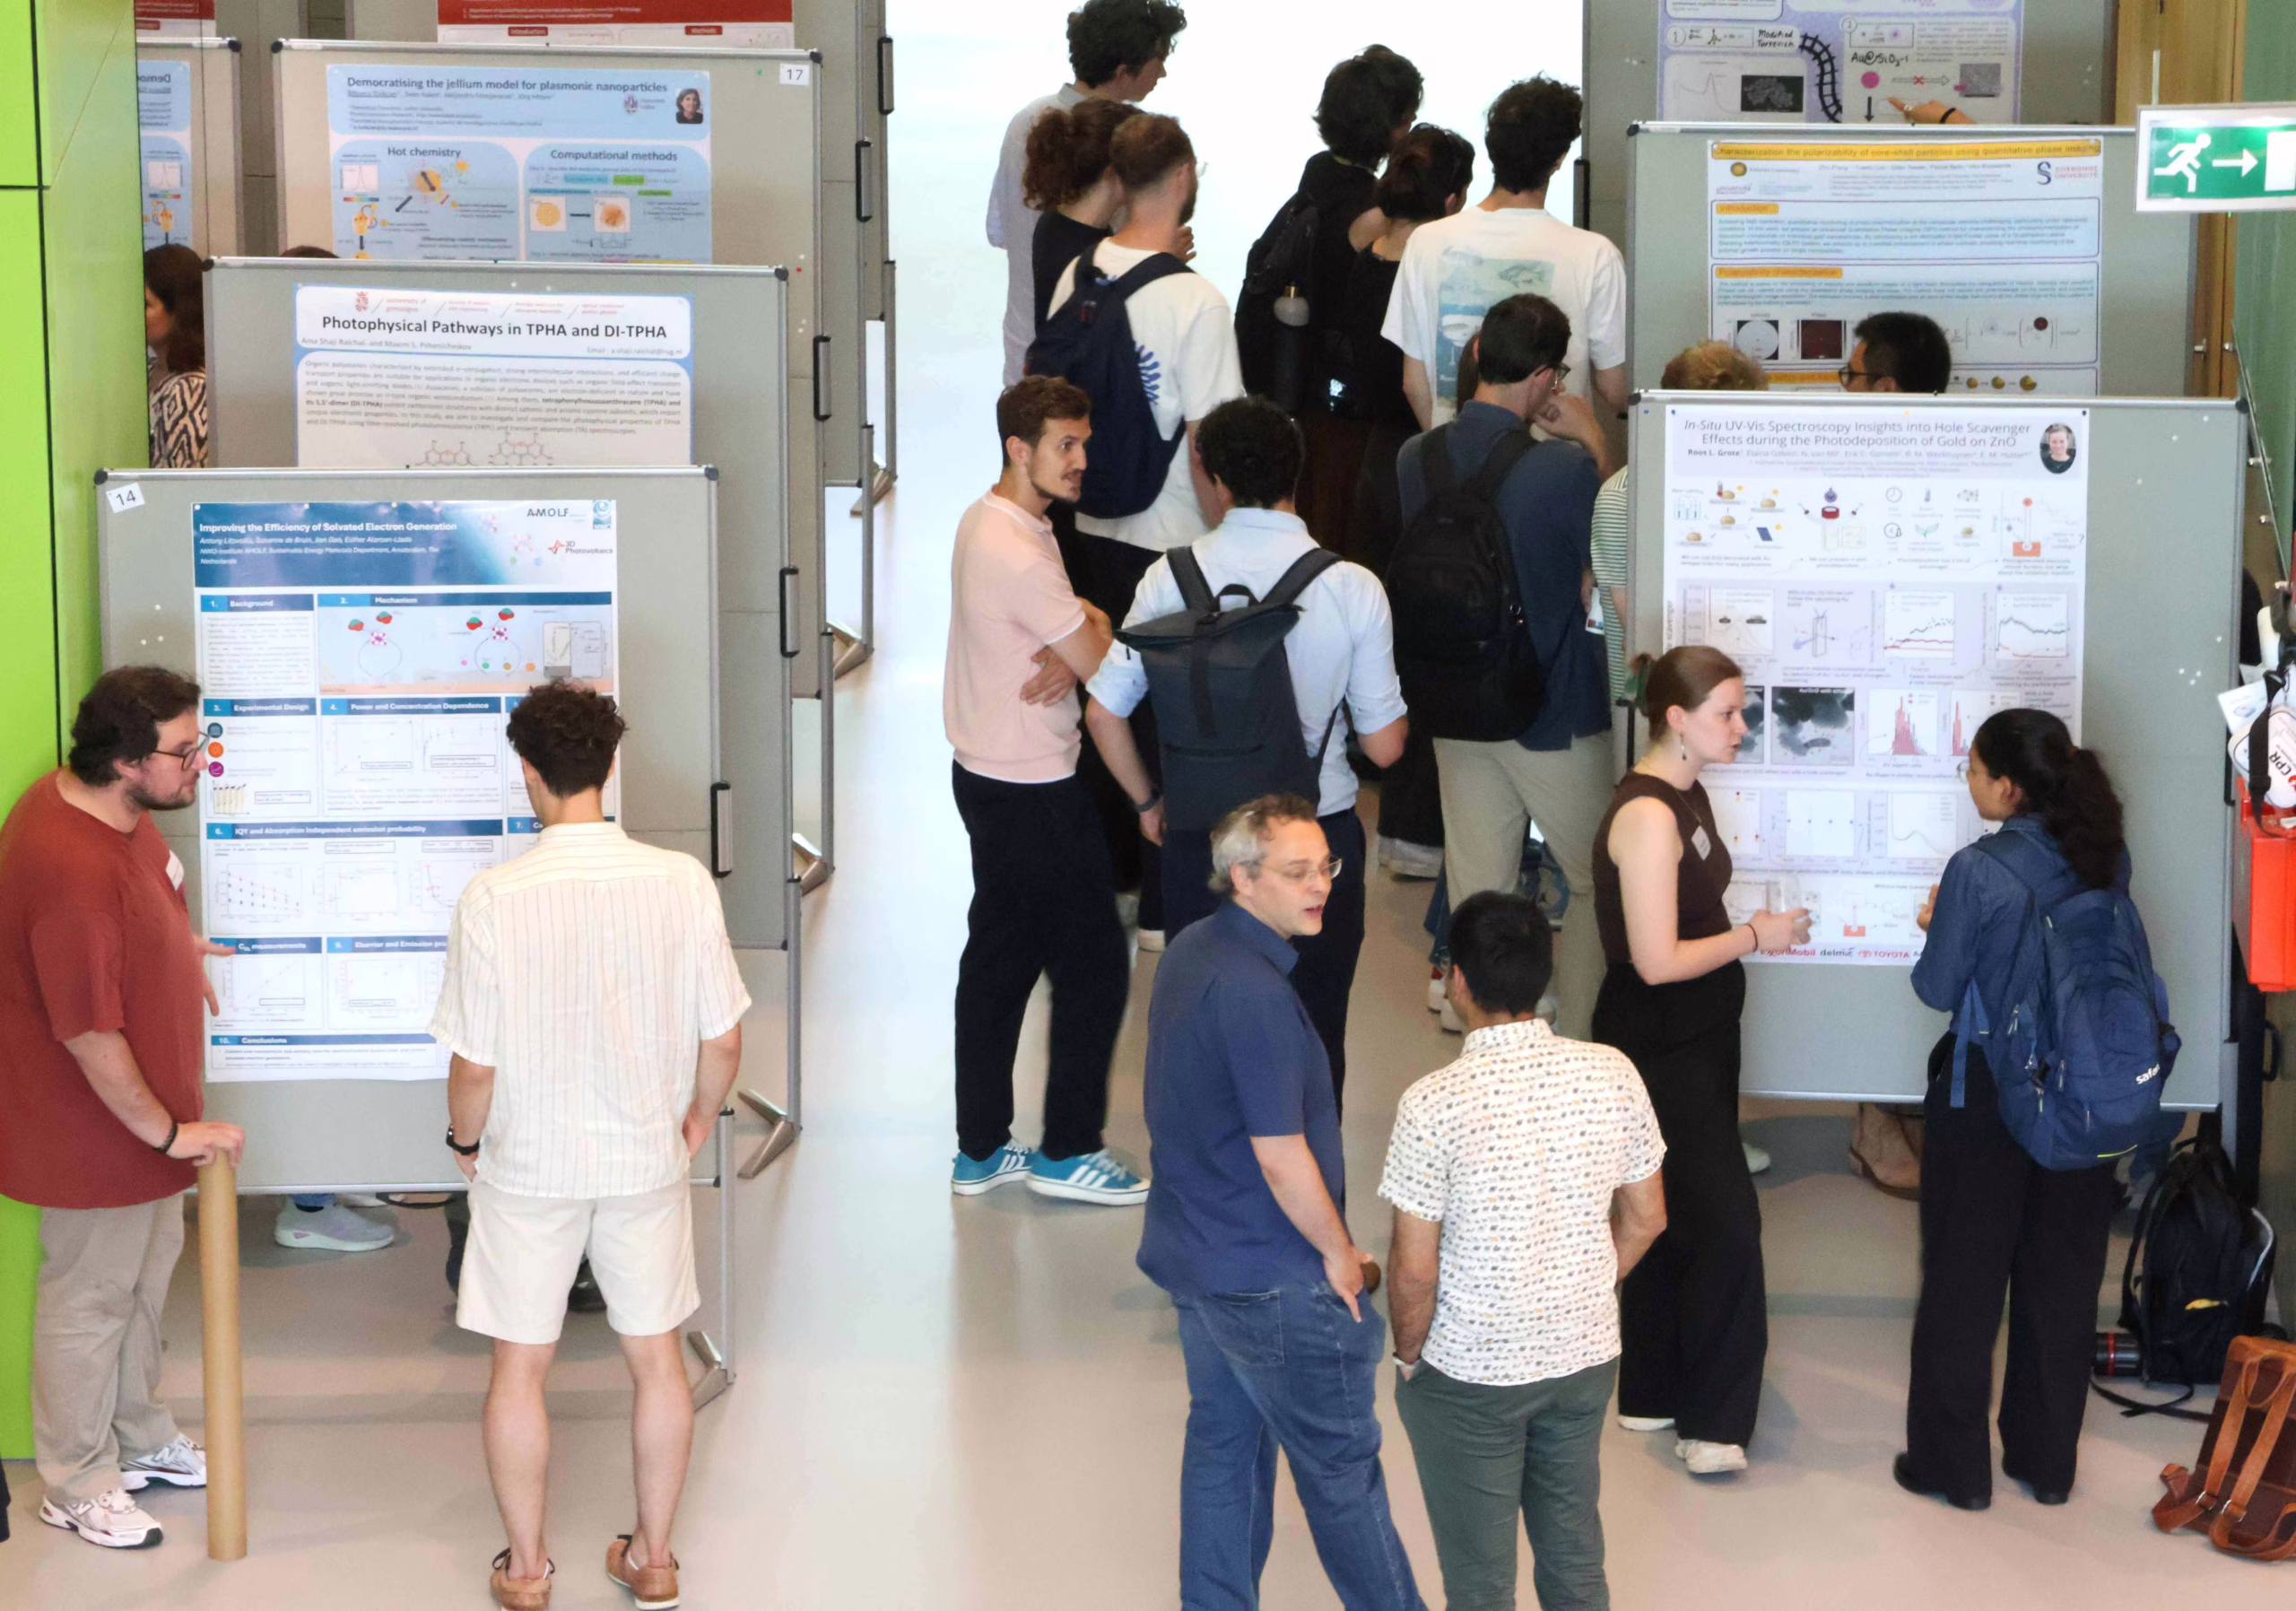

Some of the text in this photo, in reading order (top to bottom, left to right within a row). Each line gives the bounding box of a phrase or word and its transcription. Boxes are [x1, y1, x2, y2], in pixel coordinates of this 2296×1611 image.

[786, 68, 804, 81] 17
[347, 77, 667, 92] Democratising the jellium model for plasmonic nanoparticles
[387, 147, 461, 159] Hot chemistry
[551, 150, 678, 161] Computational methods
[1917, 147, 1954, 157] particles
[1956, 148, 1979, 157] using
[1982, 146, 2032, 156] quantitative
[2035, 145, 2062, 155] phase
[323, 316, 667, 338] Photophysical Pathways in TPHA and DI-TPHA
[1684, 419, 2031, 436] In-Situ UV-Vis Spectroscopy Insights into Hole Scavenger
[1702, 434, 2016, 448] Effects during the Photodeposition of Gold on ZnO
[115, 490, 136, 506] 14
[527, 508, 569, 518] AMOLF
[199, 522, 457, 535] Improving the Efficiency of Solvated Electron Generation
[565, 546, 613, 554] Photovoltaics
[230, 600, 274, 609] Background
[233, 703, 282, 712] Experimental
[283, 703, 309, 712] Design
[375, 702, 388, 710] and
[443, 702, 489, 710] Dependence
[2268, 751, 2292, 776] CPR
[265, 826, 305, 835] Absorption
[387, 824, 426, 833] probability
[251, 942, 307, 950] measurements
[1820, 947, 1854, 957] delmic
[241, 1036, 288, 1045] Conclusions
